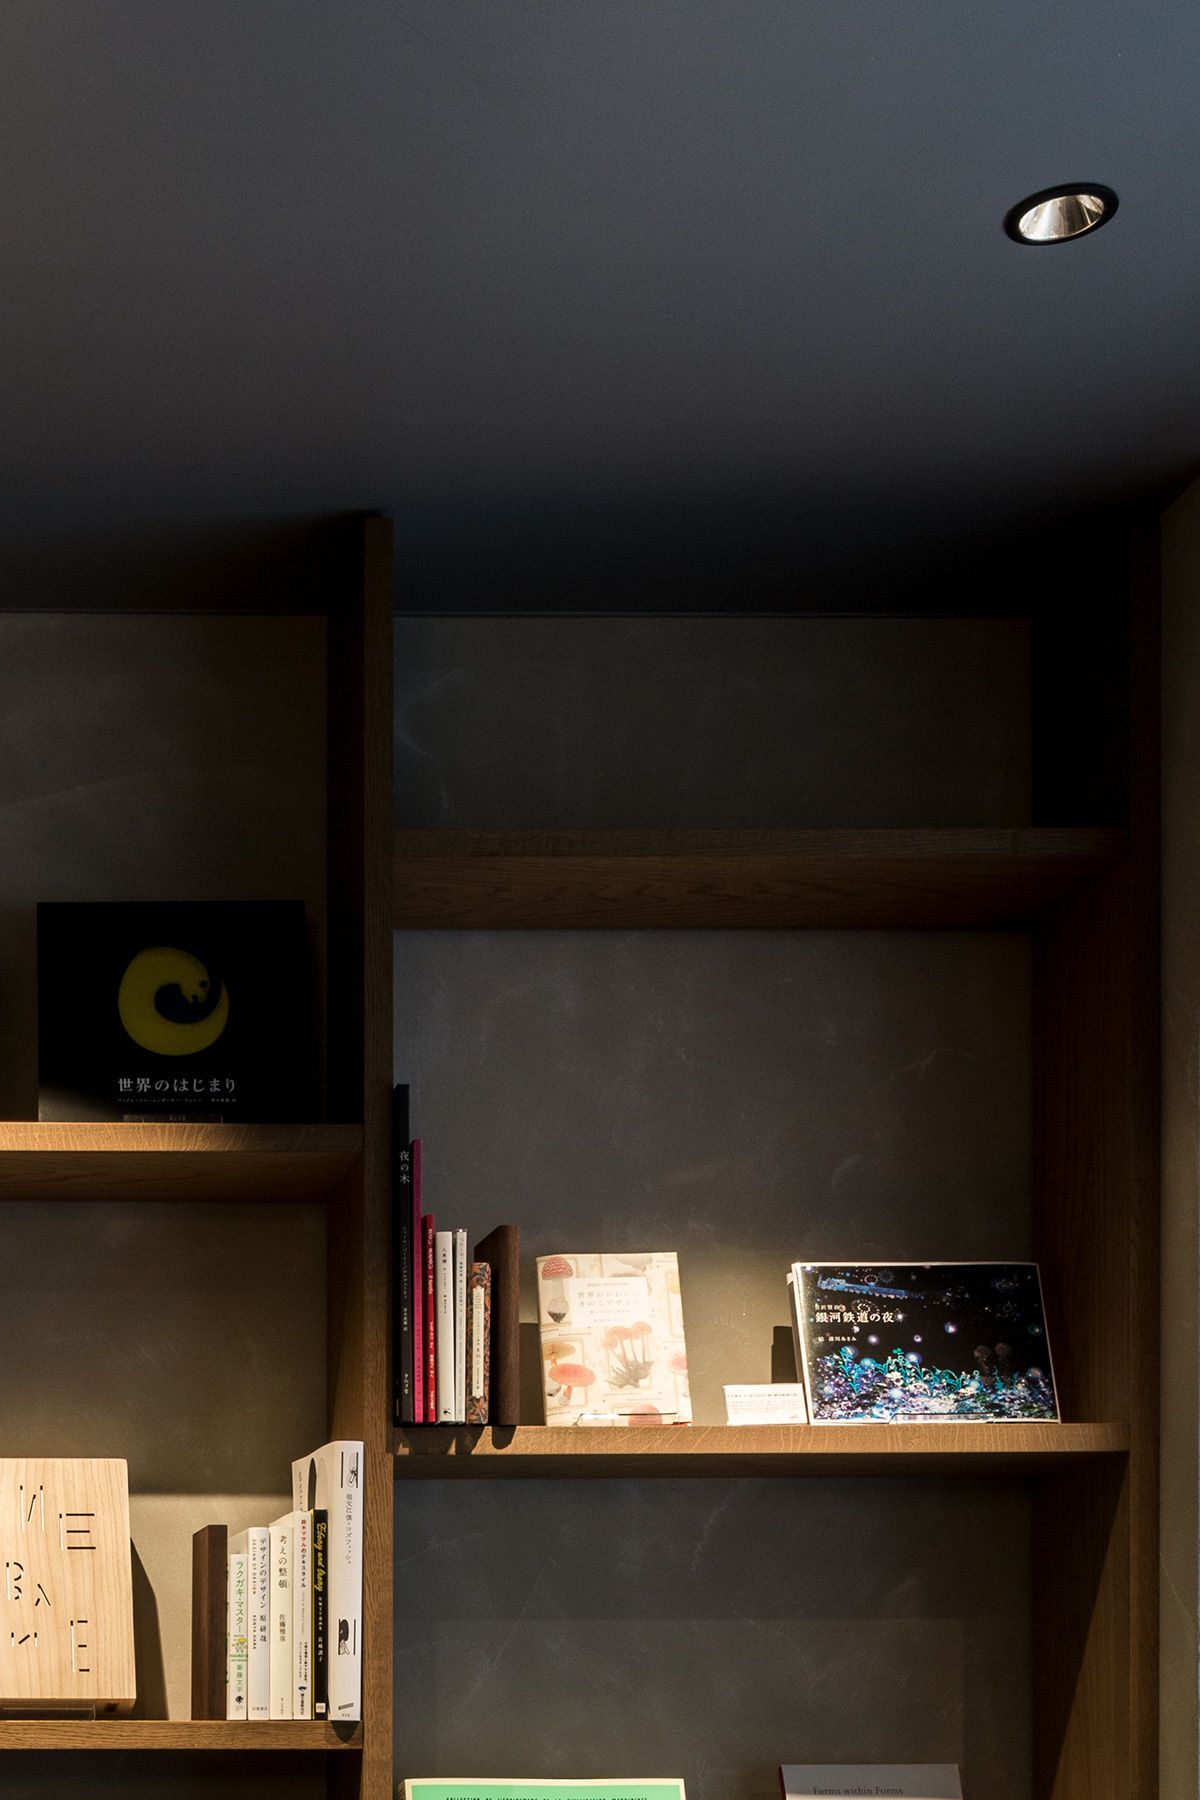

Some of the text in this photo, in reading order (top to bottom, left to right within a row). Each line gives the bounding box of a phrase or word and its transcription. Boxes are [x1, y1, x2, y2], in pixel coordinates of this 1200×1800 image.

[117, 1077, 236, 1093] 世界のはじまり
[400, 1151, 410, 1184] 夜の木
[815, 1311, 895, 1323] 銀河鉄道の夜
[259, 1537, 268, 1609] デザインのデザイン
[278, 1535, 289, 1589] 考えの整頓
[235, 1560, 246, 1633] ラクガキ・マスター
[813, 1786, 904, 1795] Forms within Forms
